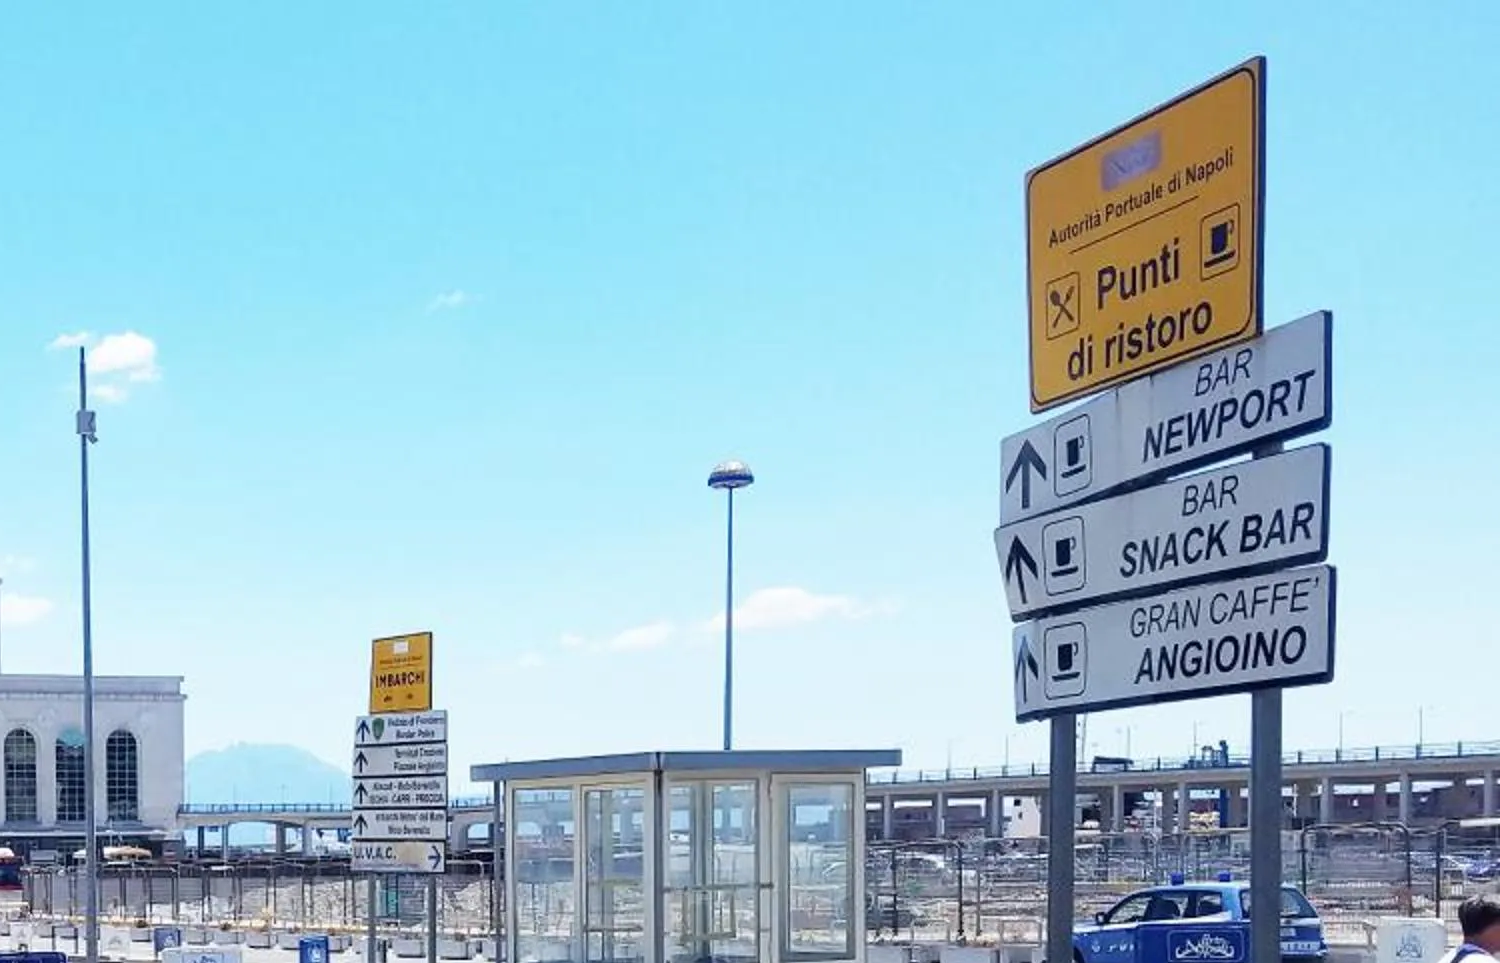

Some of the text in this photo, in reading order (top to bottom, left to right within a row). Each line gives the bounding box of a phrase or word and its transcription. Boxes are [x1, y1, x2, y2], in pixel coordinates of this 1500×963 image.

[1048, 208, 1101, 248] Autorità
[1104, 185, 1163, 223] Portuale
[1167, 173, 1182, 194] di
[1185, 146, 1234, 186] Napoli
[1096, 237, 1181, 310] Punti
[1067, 301, 1213, 381] di ristoro
[1194, 348, 1253, 397] BAR
[1143, 369, 1316, 464] NEWPORT
[1181, 475, 1240, 517] BAR
[1119, 502, 1315, 579] SNACK BAR
[1129, 603, 1200, 639] GRAN
[1134, 625, 1308, 685] ANGIOINO
